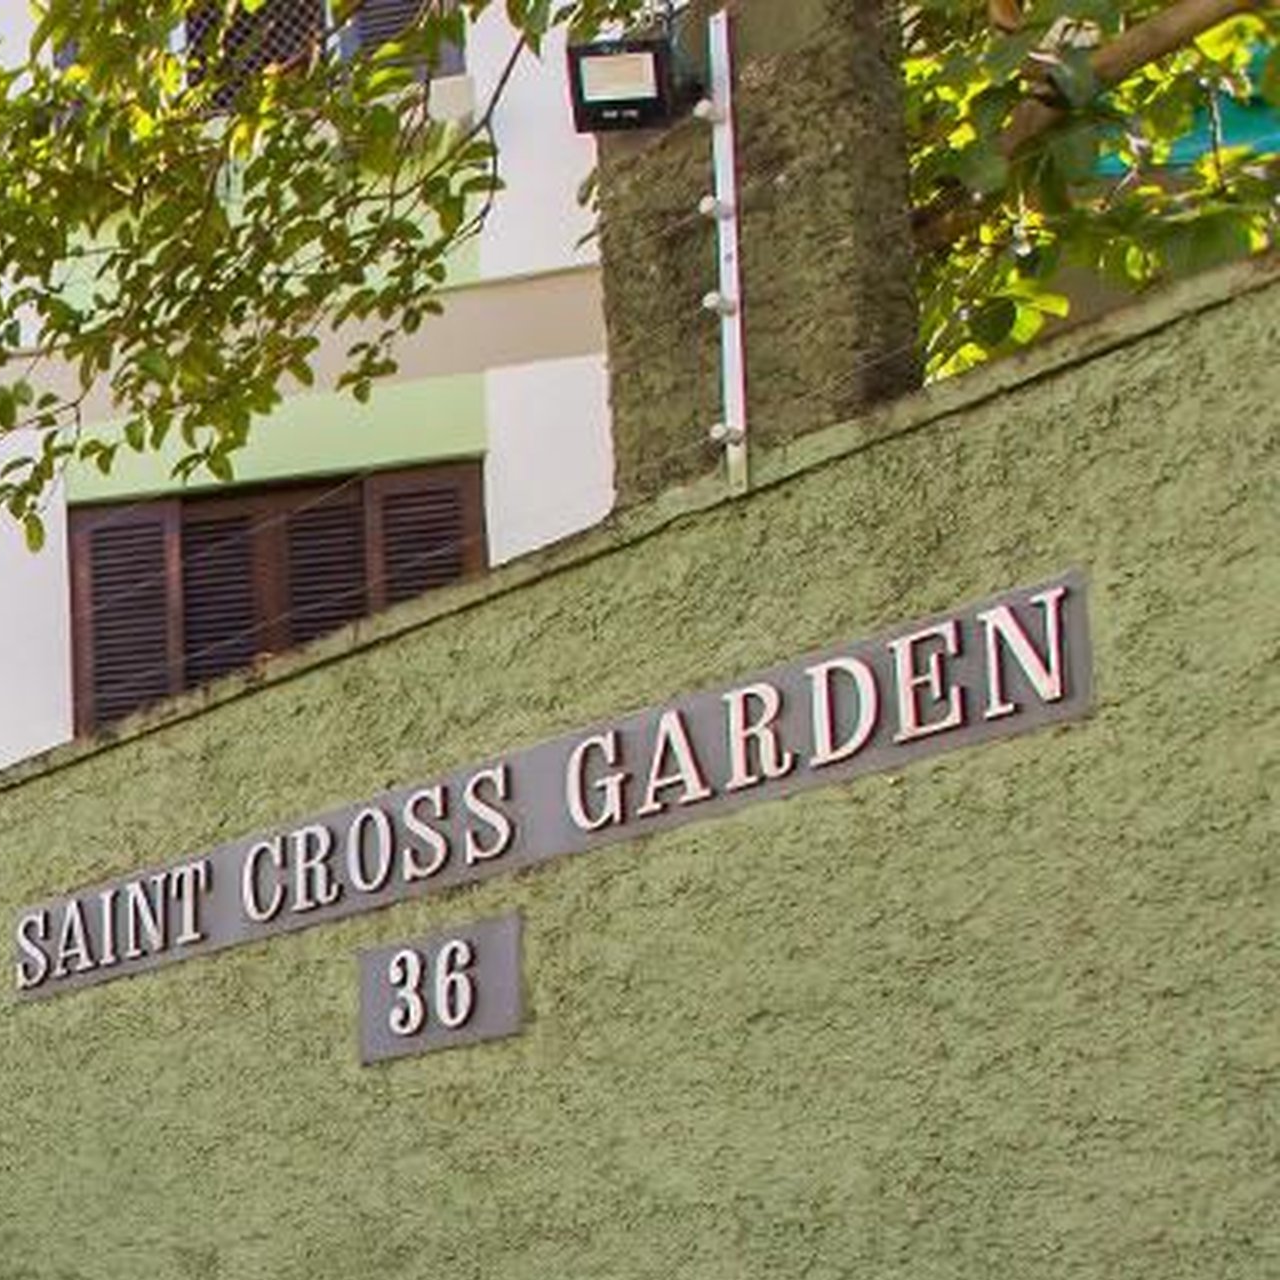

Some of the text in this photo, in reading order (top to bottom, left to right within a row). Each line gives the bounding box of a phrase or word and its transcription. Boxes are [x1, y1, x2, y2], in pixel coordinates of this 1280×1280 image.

[16, 586, 1068, 990] SAINT CROSS GARDEN
[388, 939, 474, 1036] 36
